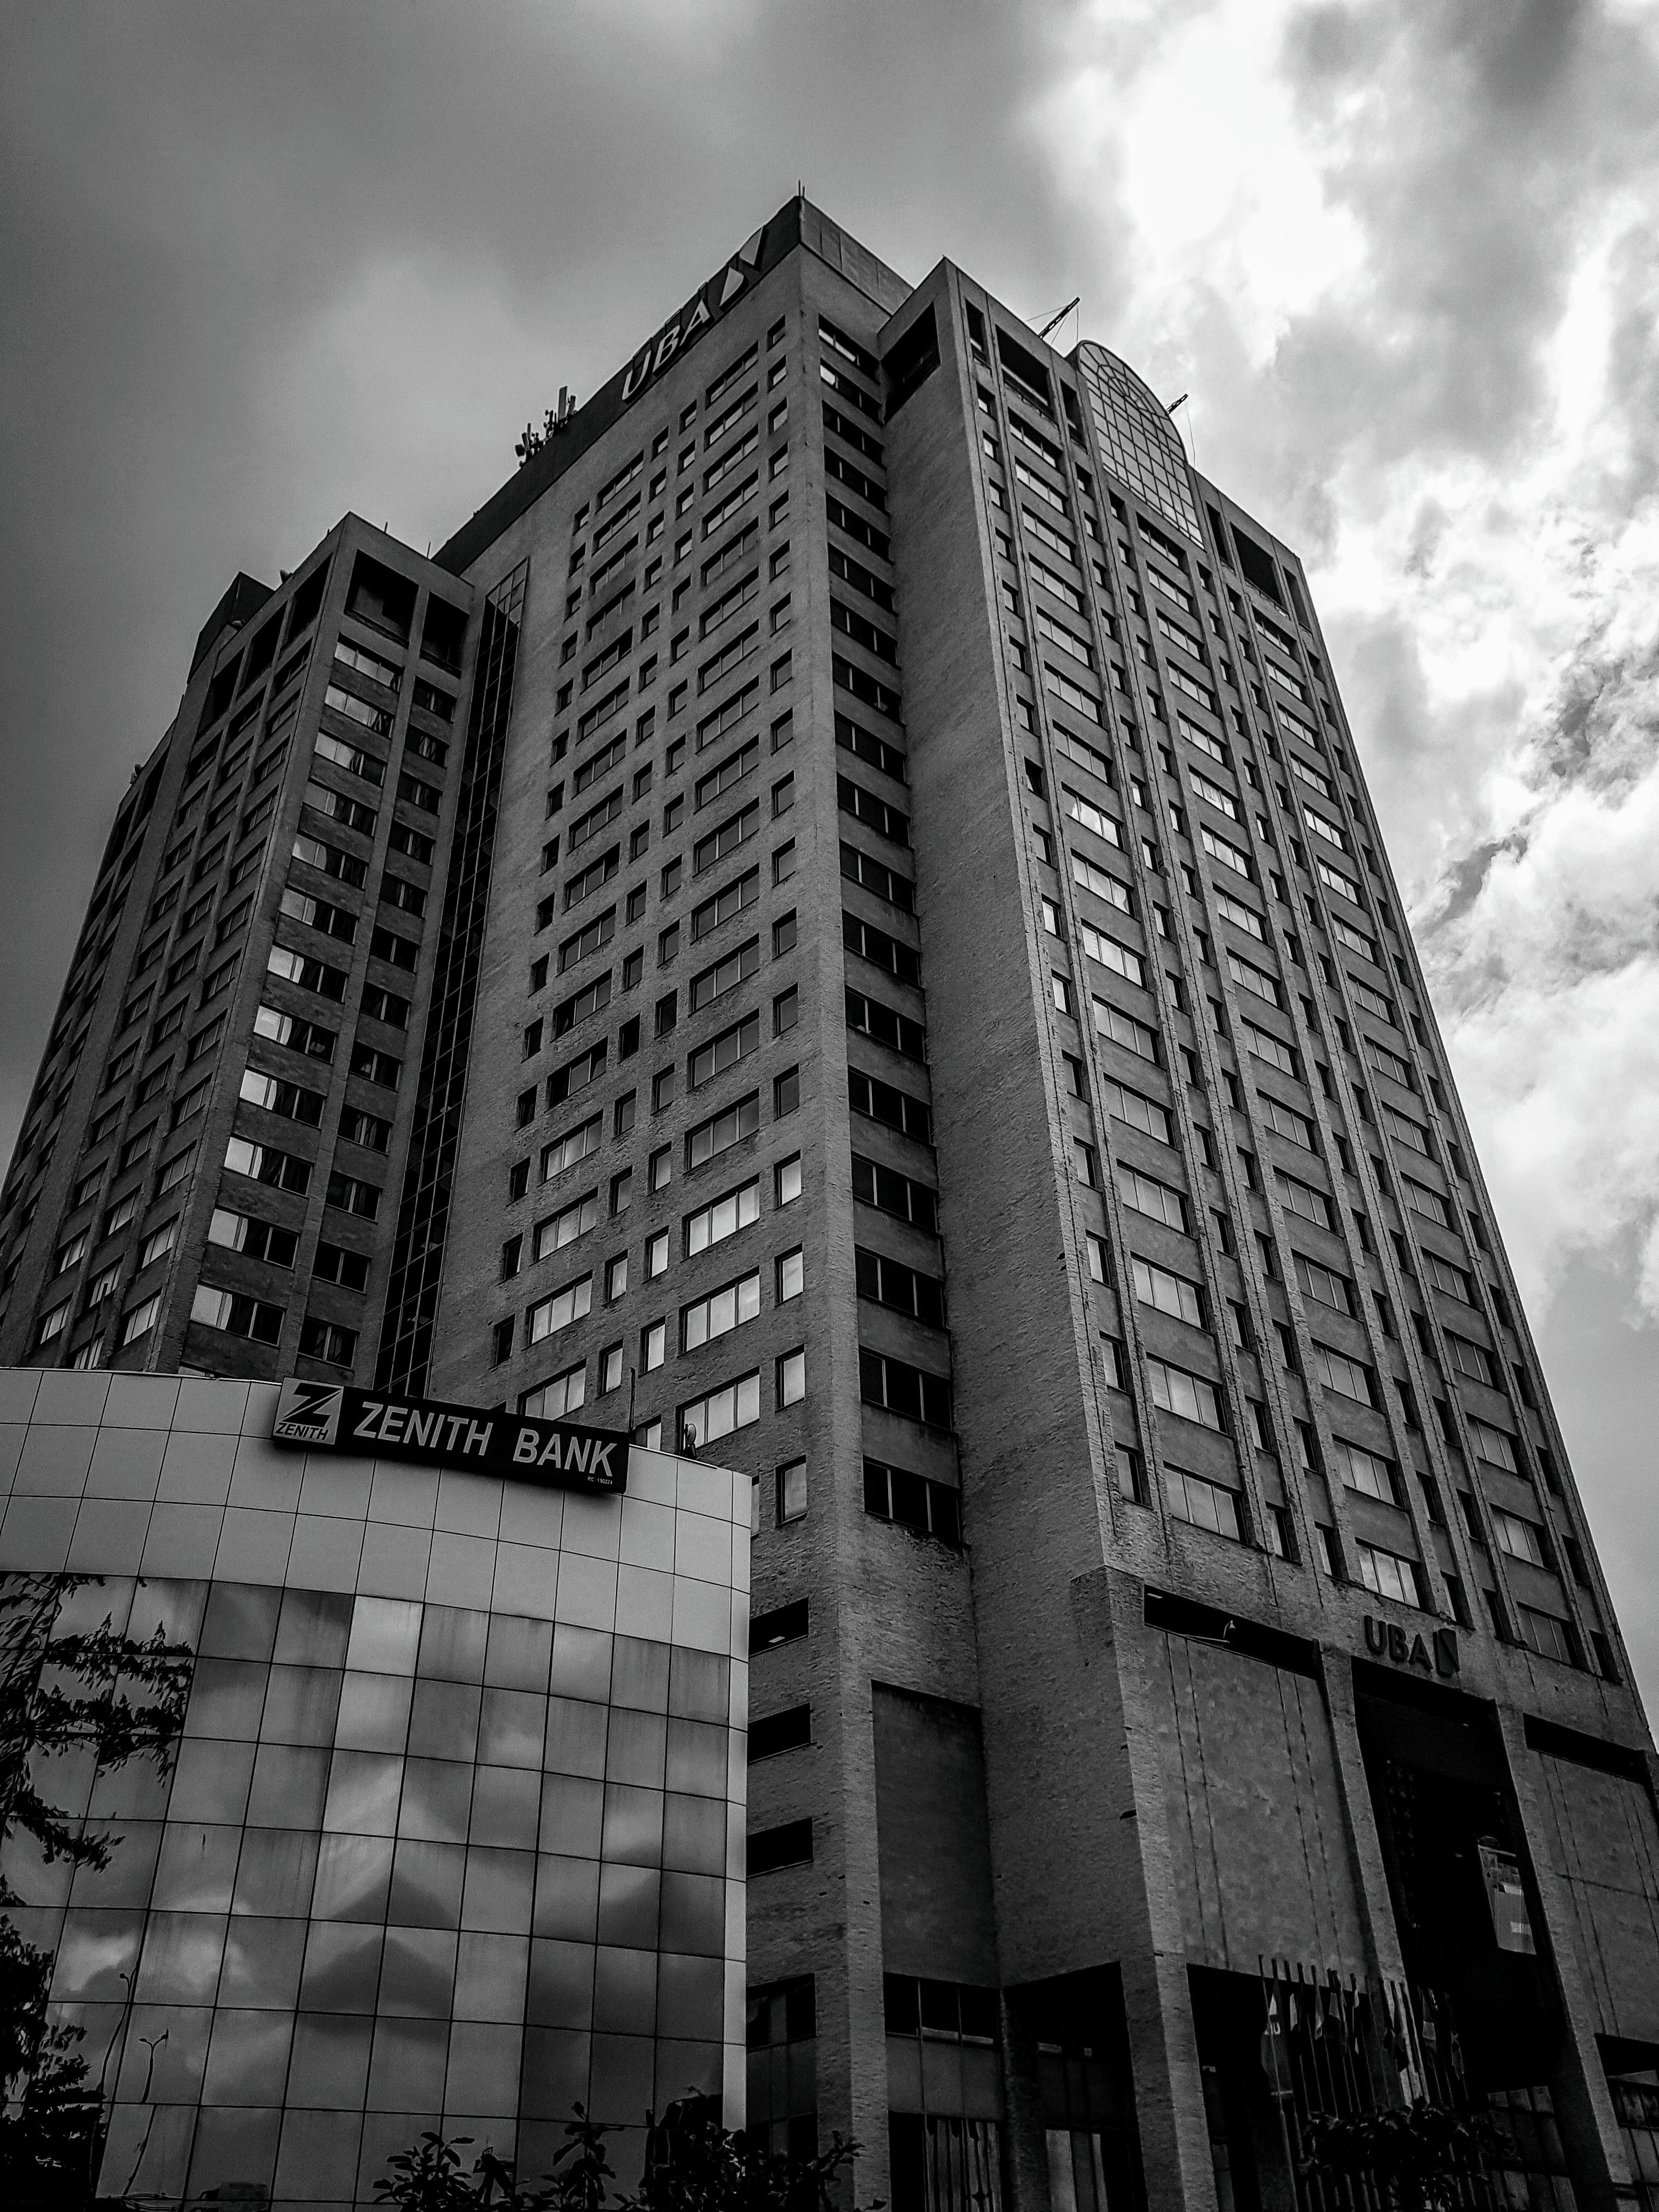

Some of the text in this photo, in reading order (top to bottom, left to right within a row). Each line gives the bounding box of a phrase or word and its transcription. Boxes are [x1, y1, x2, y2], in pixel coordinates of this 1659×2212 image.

[622, 299, 710, 400] UBA
[275, 1422, 329, 1441] ZENITH
[353, 1401, 618, 1477] ZENITH BANK
[1364, 1615, 1433, 1672] UBA
